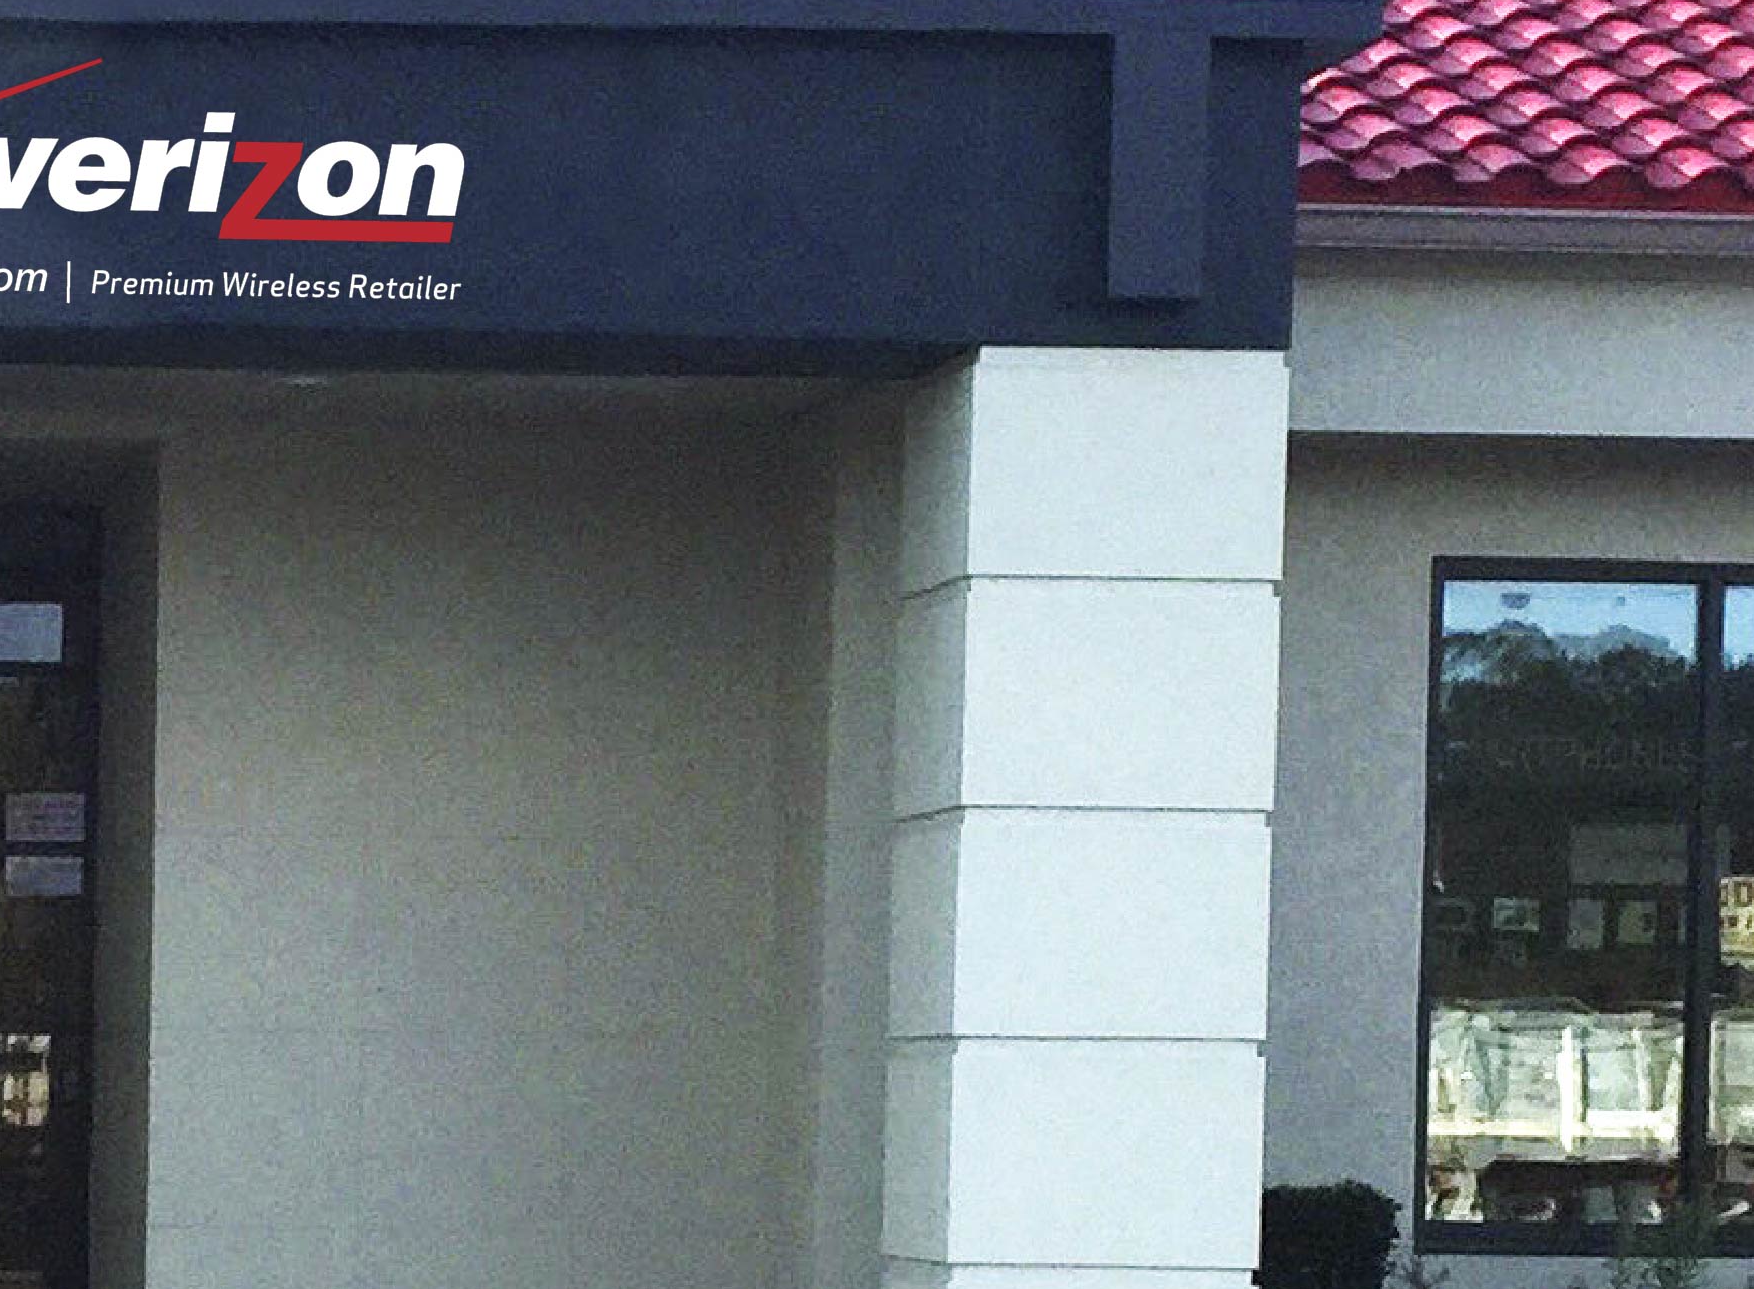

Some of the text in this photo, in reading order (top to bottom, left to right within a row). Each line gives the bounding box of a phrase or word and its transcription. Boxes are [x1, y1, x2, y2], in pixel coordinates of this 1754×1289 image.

[90, 269, 215, 297] Premium
[222, 271, 341, 300] Wireless
[347, 272, 463, 301] Retailer
